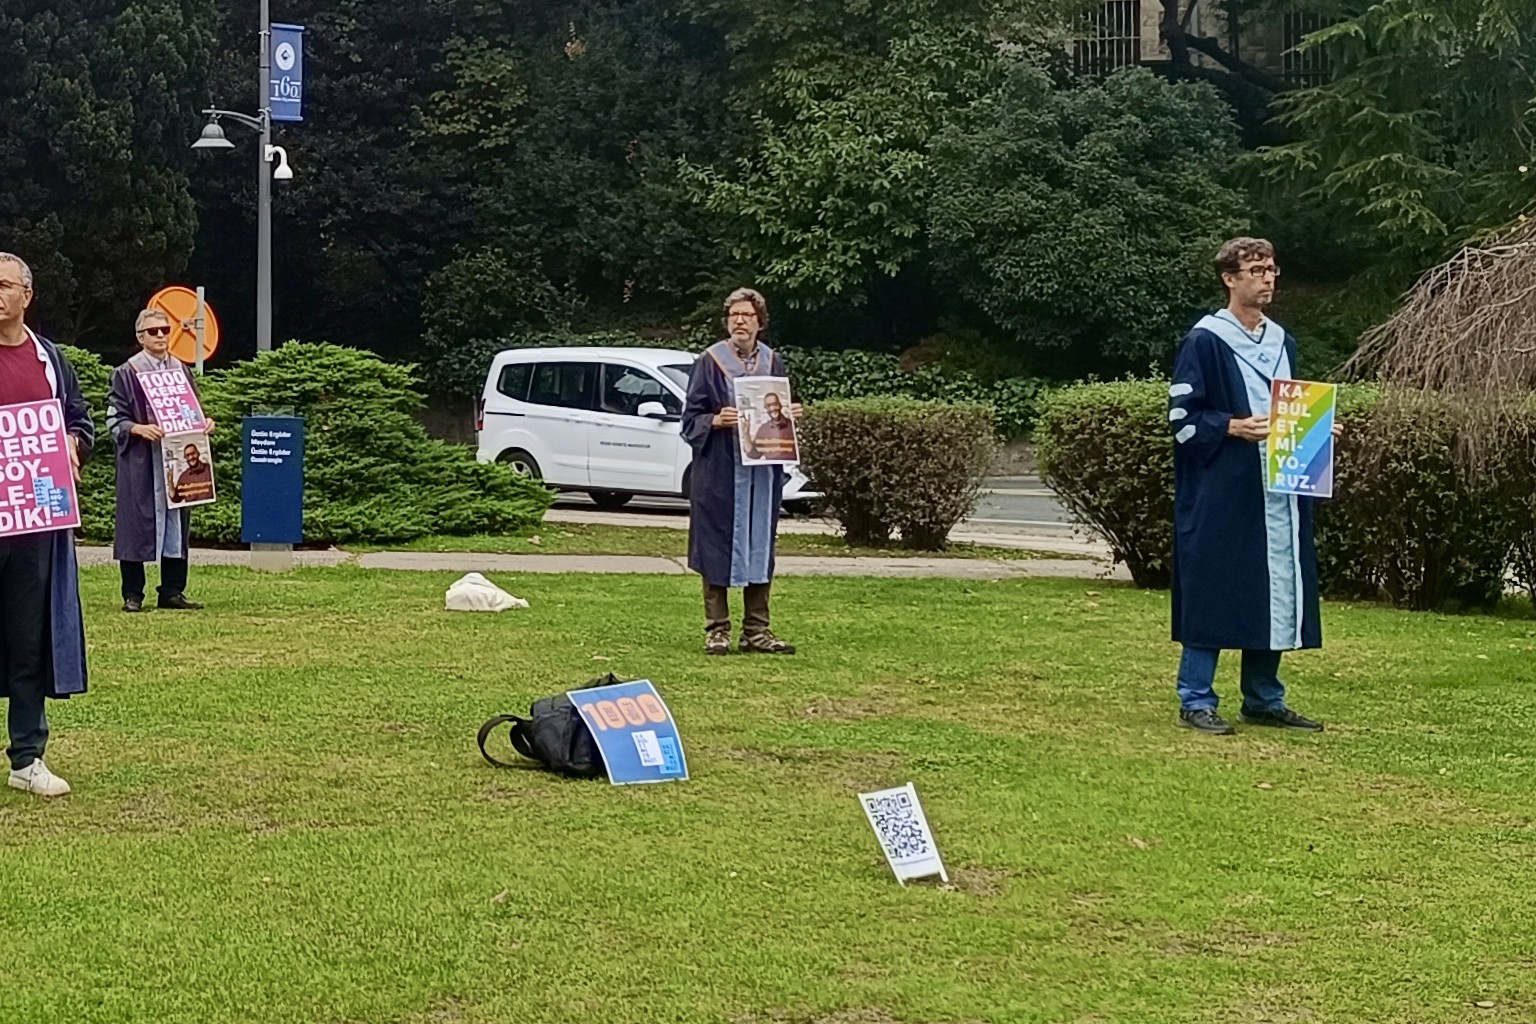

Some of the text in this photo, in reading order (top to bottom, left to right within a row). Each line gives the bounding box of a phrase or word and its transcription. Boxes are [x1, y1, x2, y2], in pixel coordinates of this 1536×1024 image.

[274, 75, 299, 98] 160
[140, 371, 186, 387] 1000
[147, 385, 188, 397] KERE
[1279, 383, 1310, 398] KA-
[157, 408, 182, 420] LE-
[1277, 401, 1311, 417] BUL
[1276, 419, 1304, 433] ET-
[1275, 434, 1303, 452] Mİ-
[1275, 454, 1308, 470] YO-
[1275, 473, 1316, 490] RUZ.
[581, 694, 667, 731] 1000
